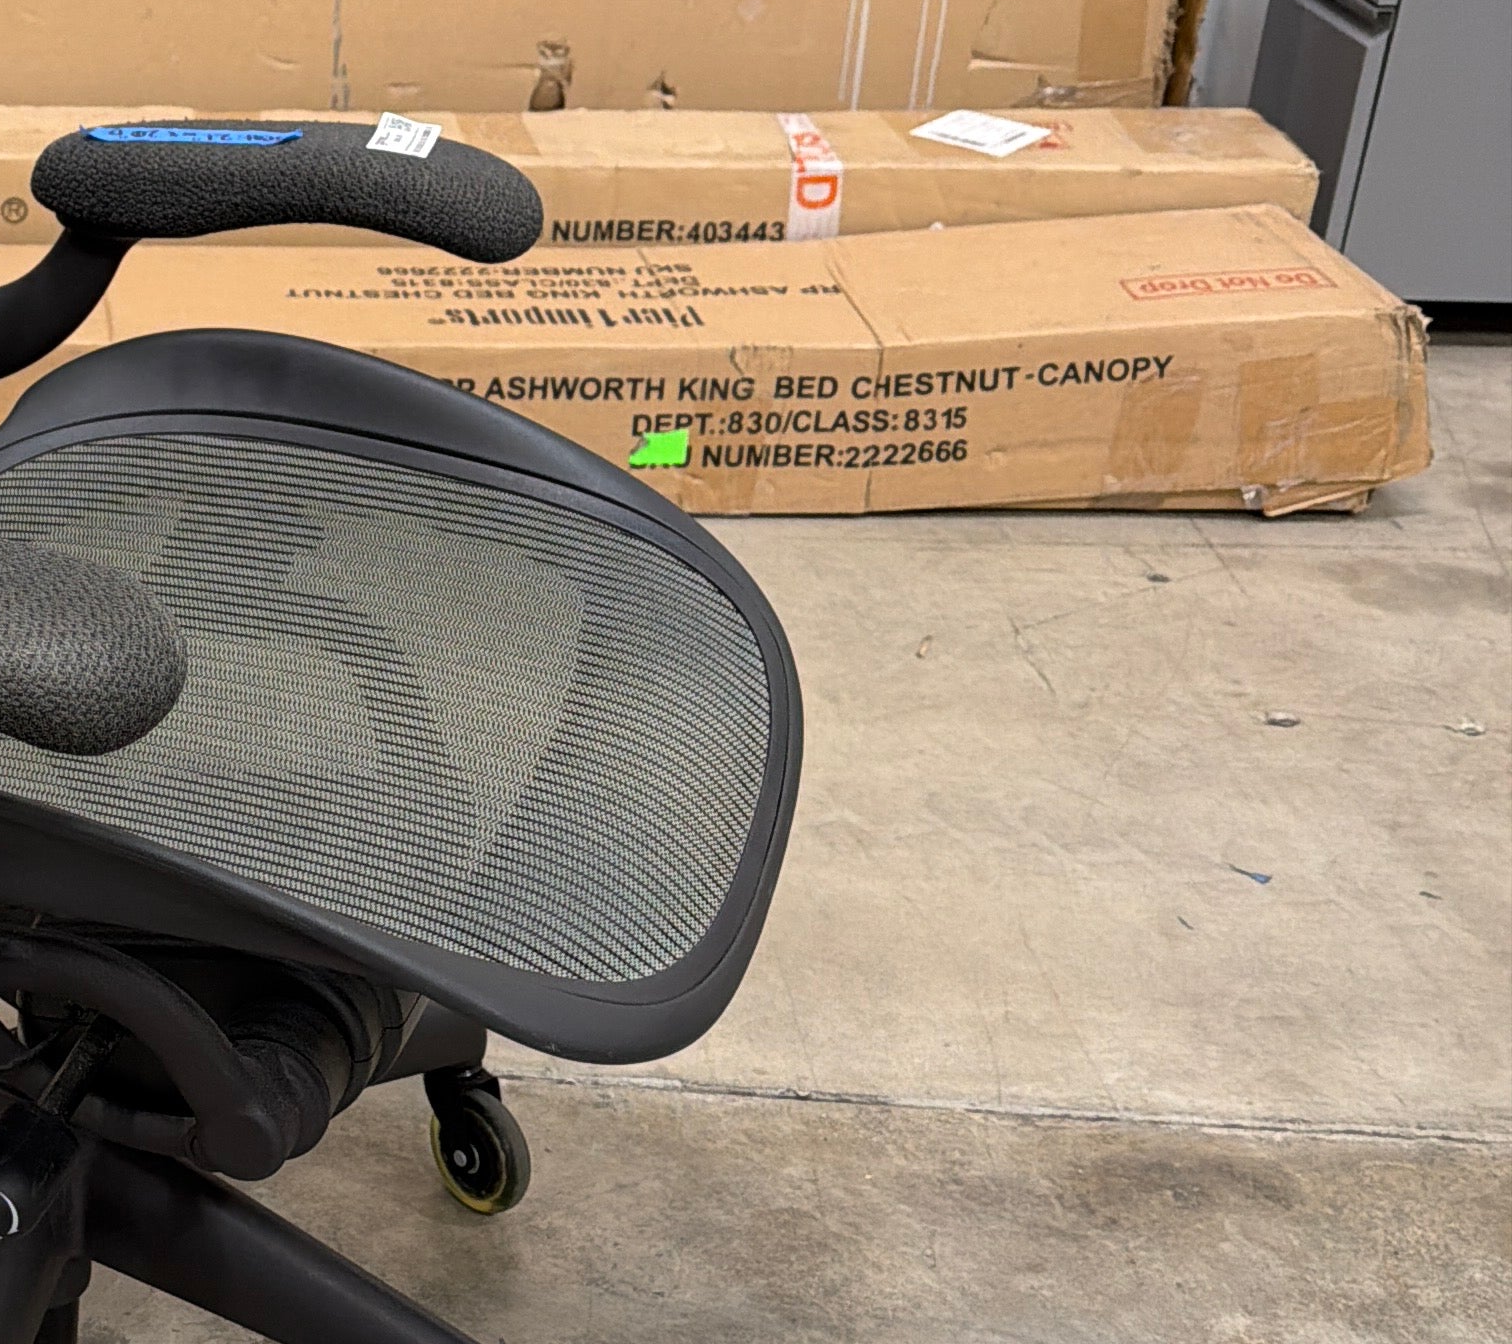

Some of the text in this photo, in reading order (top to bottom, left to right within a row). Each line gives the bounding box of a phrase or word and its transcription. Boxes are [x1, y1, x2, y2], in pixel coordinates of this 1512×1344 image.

[551, 219, 786, 243] NUMBER:403443
[619, 285, 788, 299] ASHWORTH
[1140, 272, 1318, 292] Do Not Drop
[286, 288, 442, 299] CHESTNUT
[453, 289, 515, 299] BED
[526, 289, 600, 299] KING
[622, 306, 704, 327] Pier
[484, 375, 664, 401] ASHWORTH
[677, 377, 755, 401] KING
[773, 375, 838, 399] BED
[701, 439, 968, 468] NUMBER:2222666
